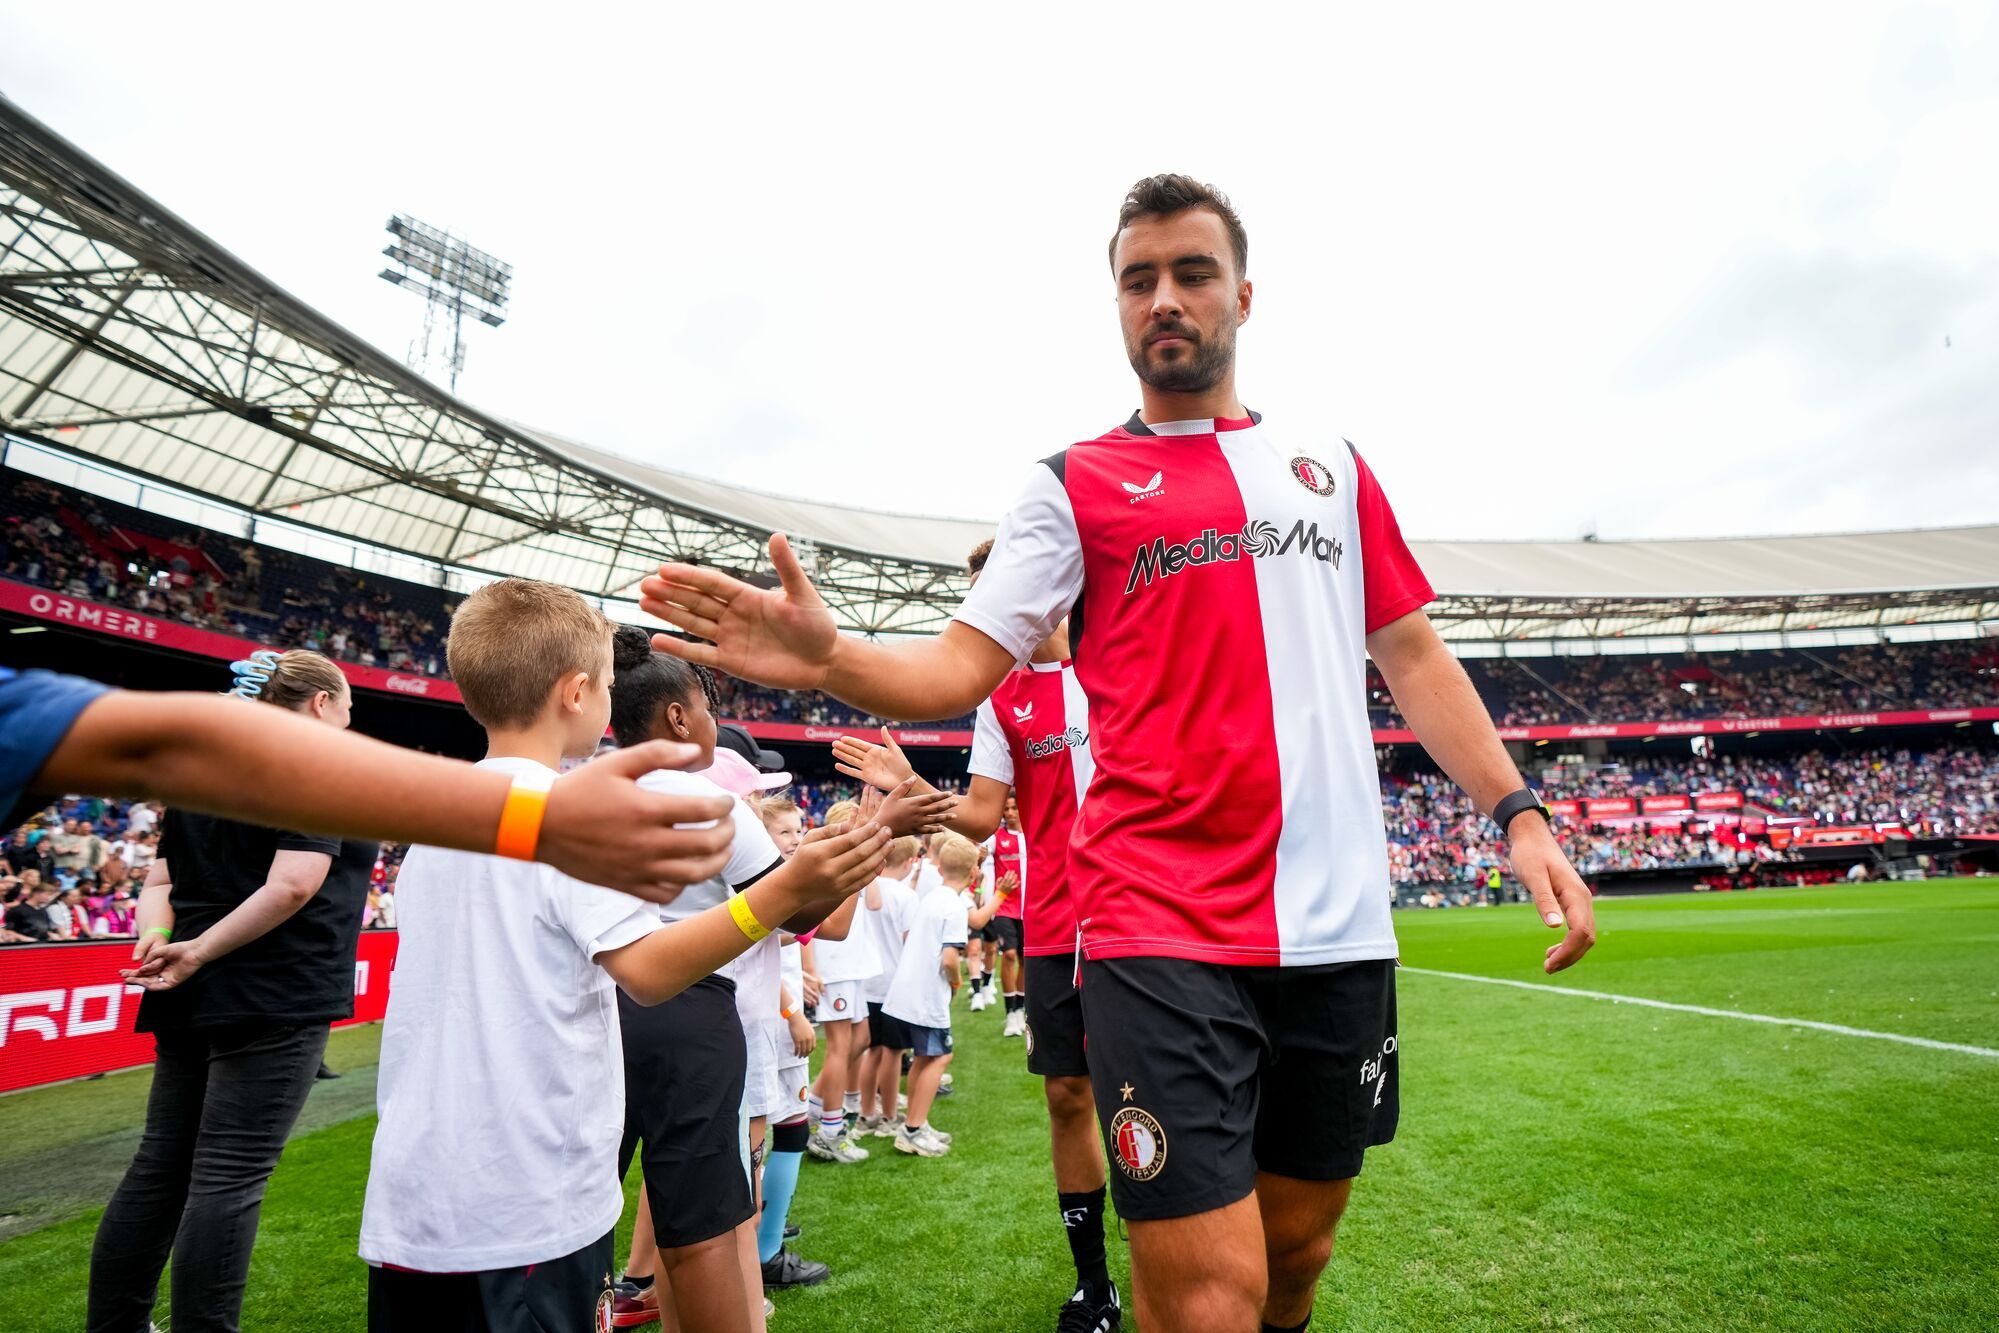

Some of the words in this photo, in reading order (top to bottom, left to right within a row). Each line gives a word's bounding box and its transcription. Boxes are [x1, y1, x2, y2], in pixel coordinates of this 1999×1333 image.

[1129, 489, 1165, 504] CASTORE
[1124, 528, 1240, 595] Media
[1276, 519, 1343, 571] Markt
[29, 594, 142, 635] ORMER
[1113, 1111, 1158, 1136] FEYENOORD
[1116, 1151, 1164, 1178] ROTTERDAM
